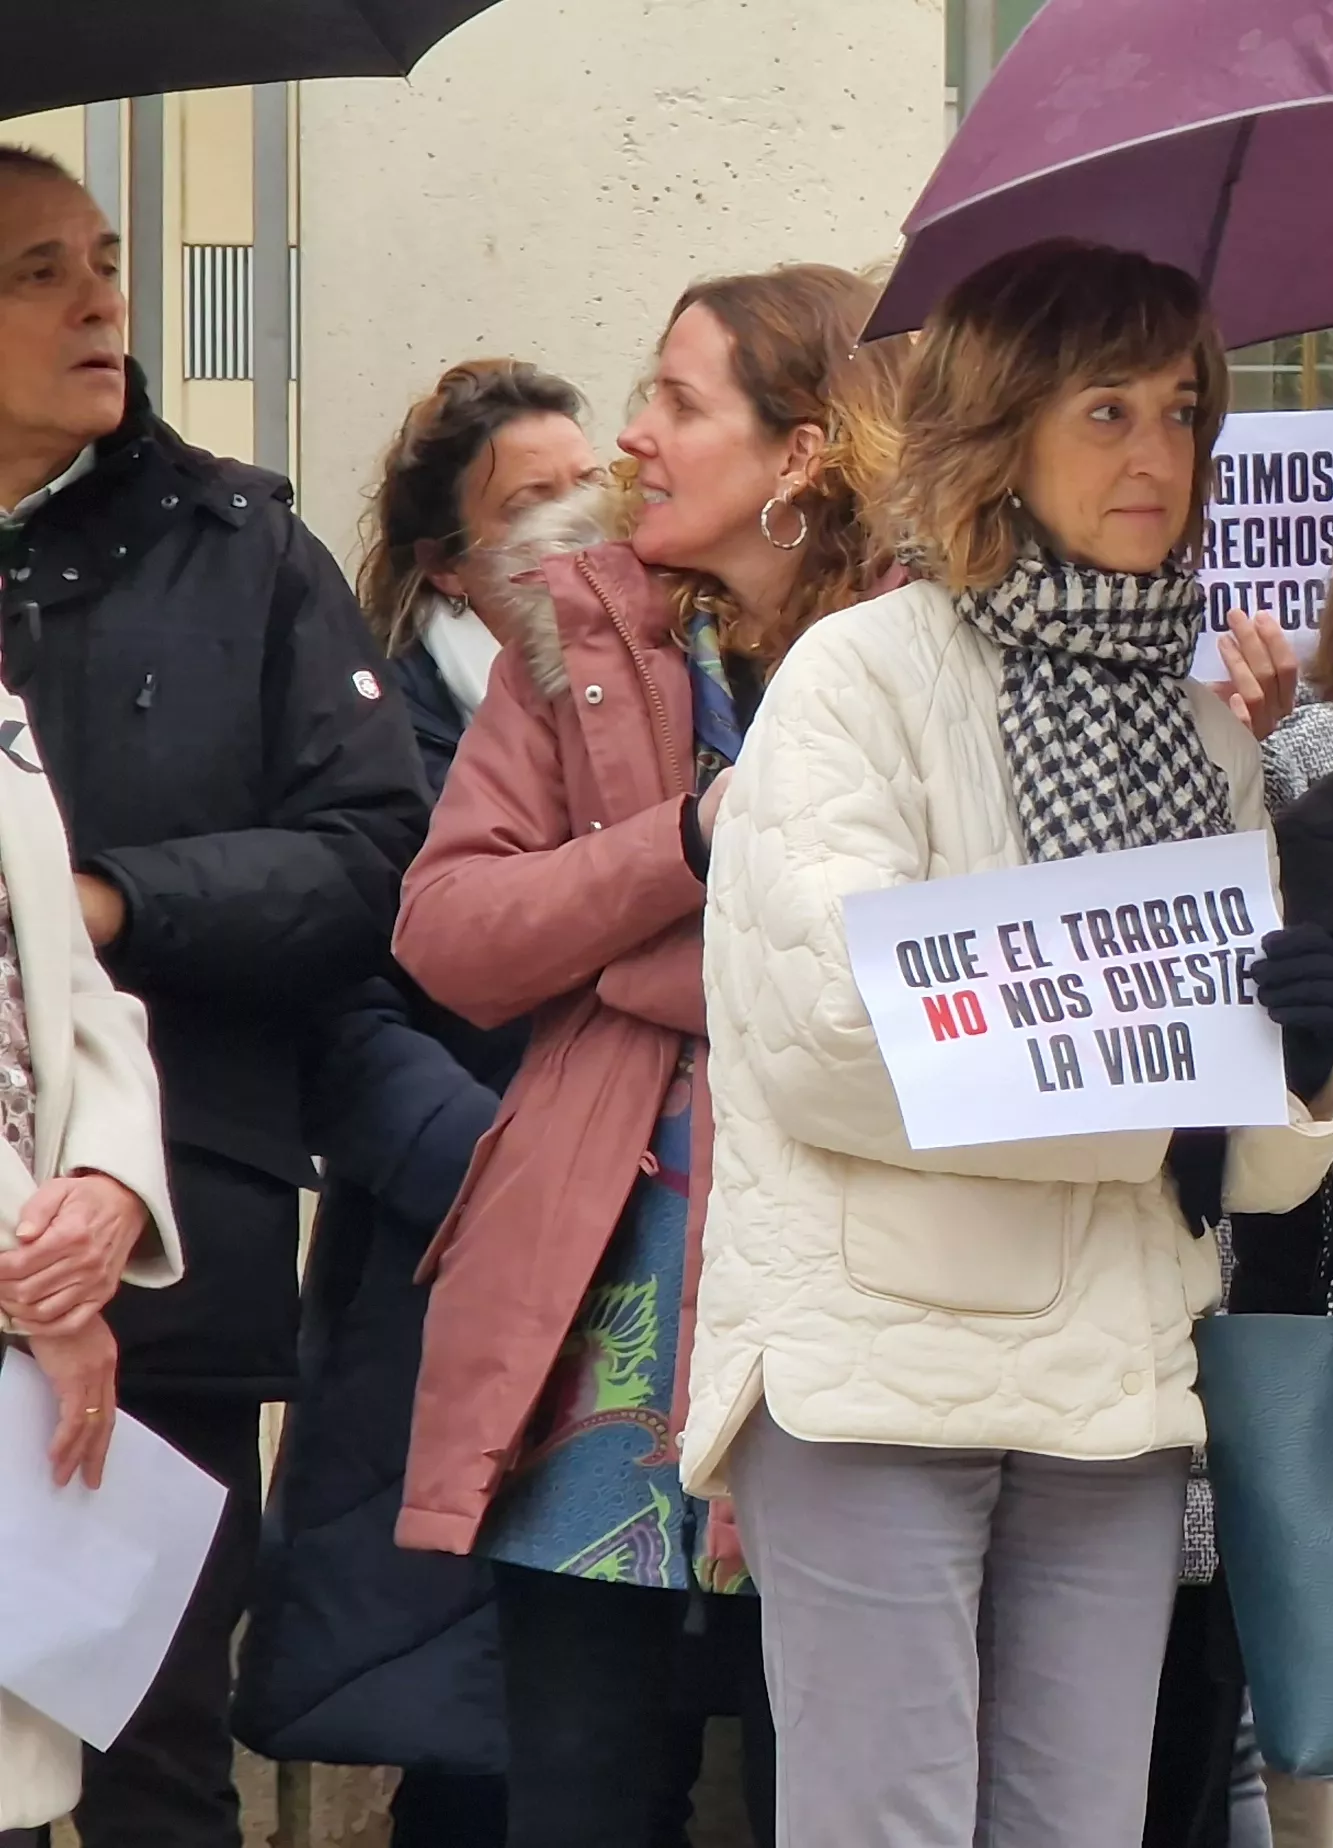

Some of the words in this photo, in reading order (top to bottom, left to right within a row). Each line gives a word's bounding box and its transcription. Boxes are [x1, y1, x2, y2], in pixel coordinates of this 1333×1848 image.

[1214, 451, 1333, 506] GIMOS
[895, 930, 988, 988] QUE
[997, 920, 1053, 973] EL
[1060, 886, 1255, 961] TRABAJO
[922, 989, 988, 1042] NO
[998, 973, 1092, 1029] NOS
[1102, 947, 1257, 1014] CUESTE
[1027, 1034, 1084, 1093] LA
[1094, 1021, 1196, 1086] VIDA
